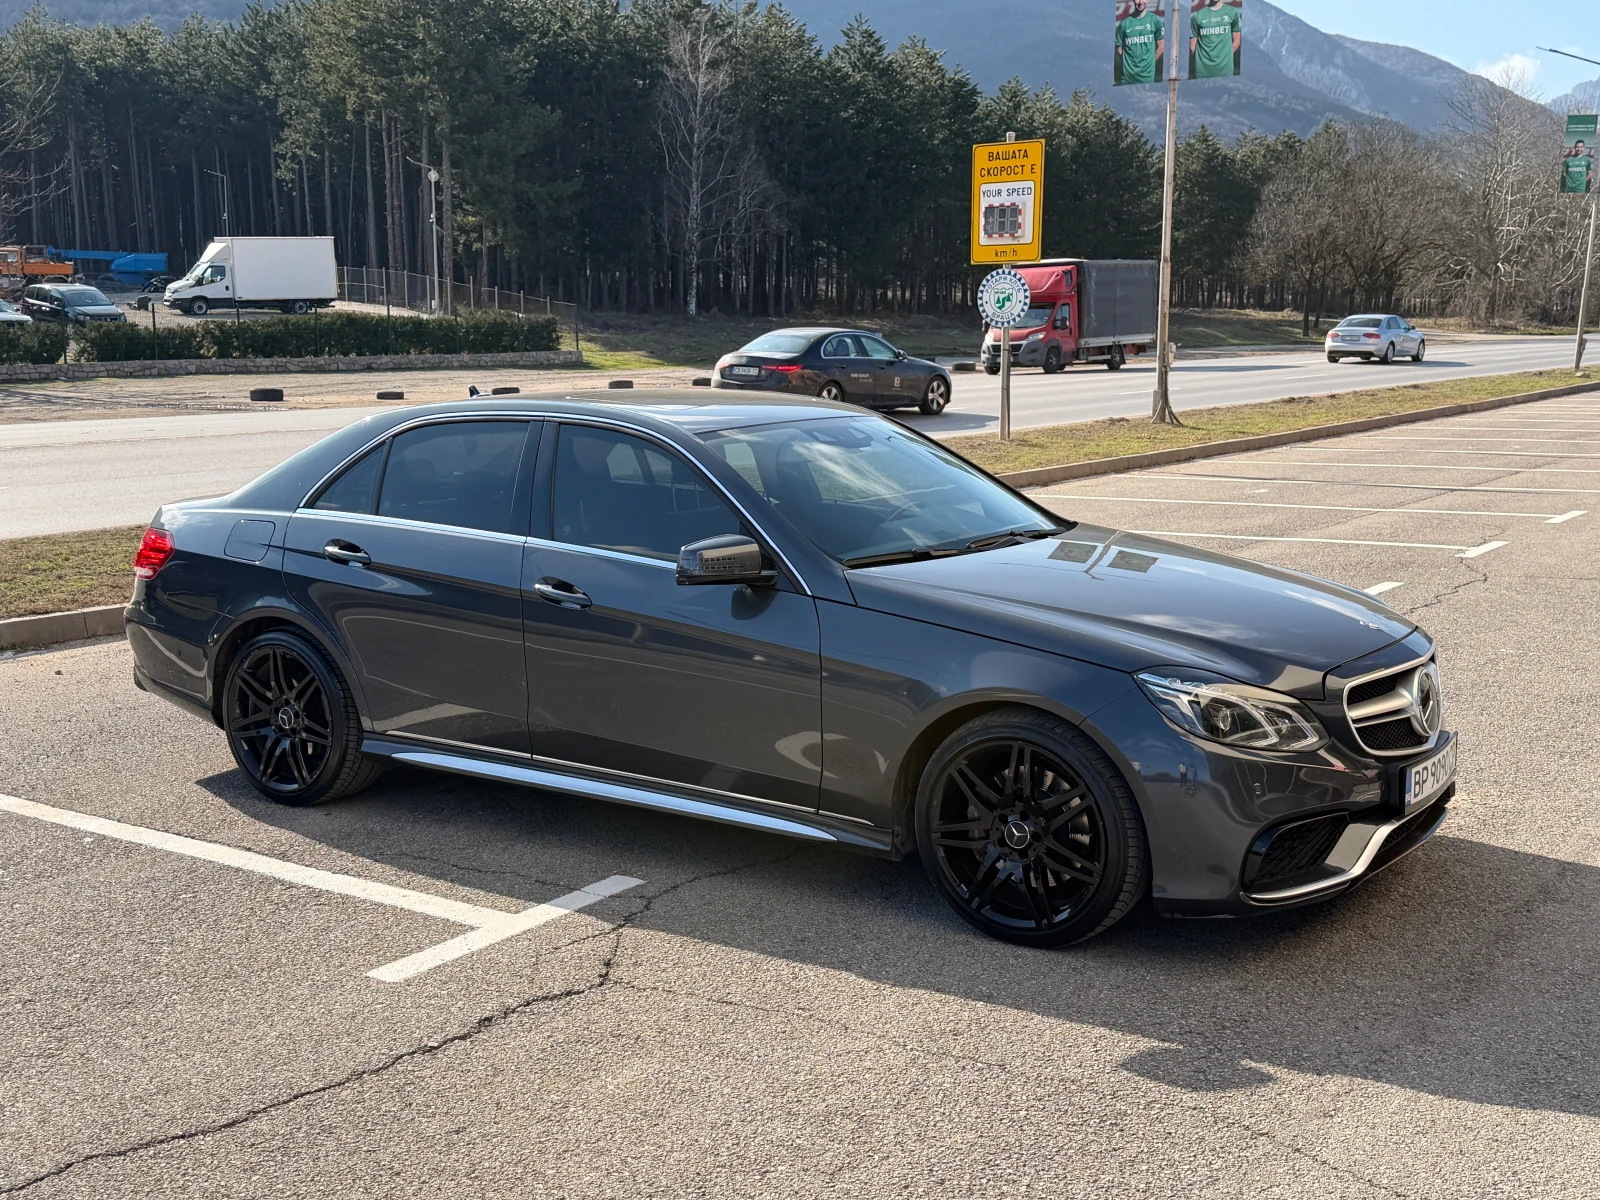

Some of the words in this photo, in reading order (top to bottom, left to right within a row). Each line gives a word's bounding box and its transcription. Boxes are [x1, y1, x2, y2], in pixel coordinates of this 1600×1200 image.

[1199, 25, 1230, 36] WINBET
[1124, 34, 1154, 45] WINBET
[988, 149, 1029, 162] ВАШАТА
[979, 164, 1026, 178] СКОРОСТ
[1030, 163, 1037, 174] Е
[981, 188, 1003, 198] YOUR
[1006, 186, 1033, 197] SPEED
[994, 248, 1018, 258] km/h
[984, 275, 1008, 294] РОТАРИ
[1008, 278, 1023, 293] КЛУБ
[990, 311, 1015, 320] ВРАЦА
